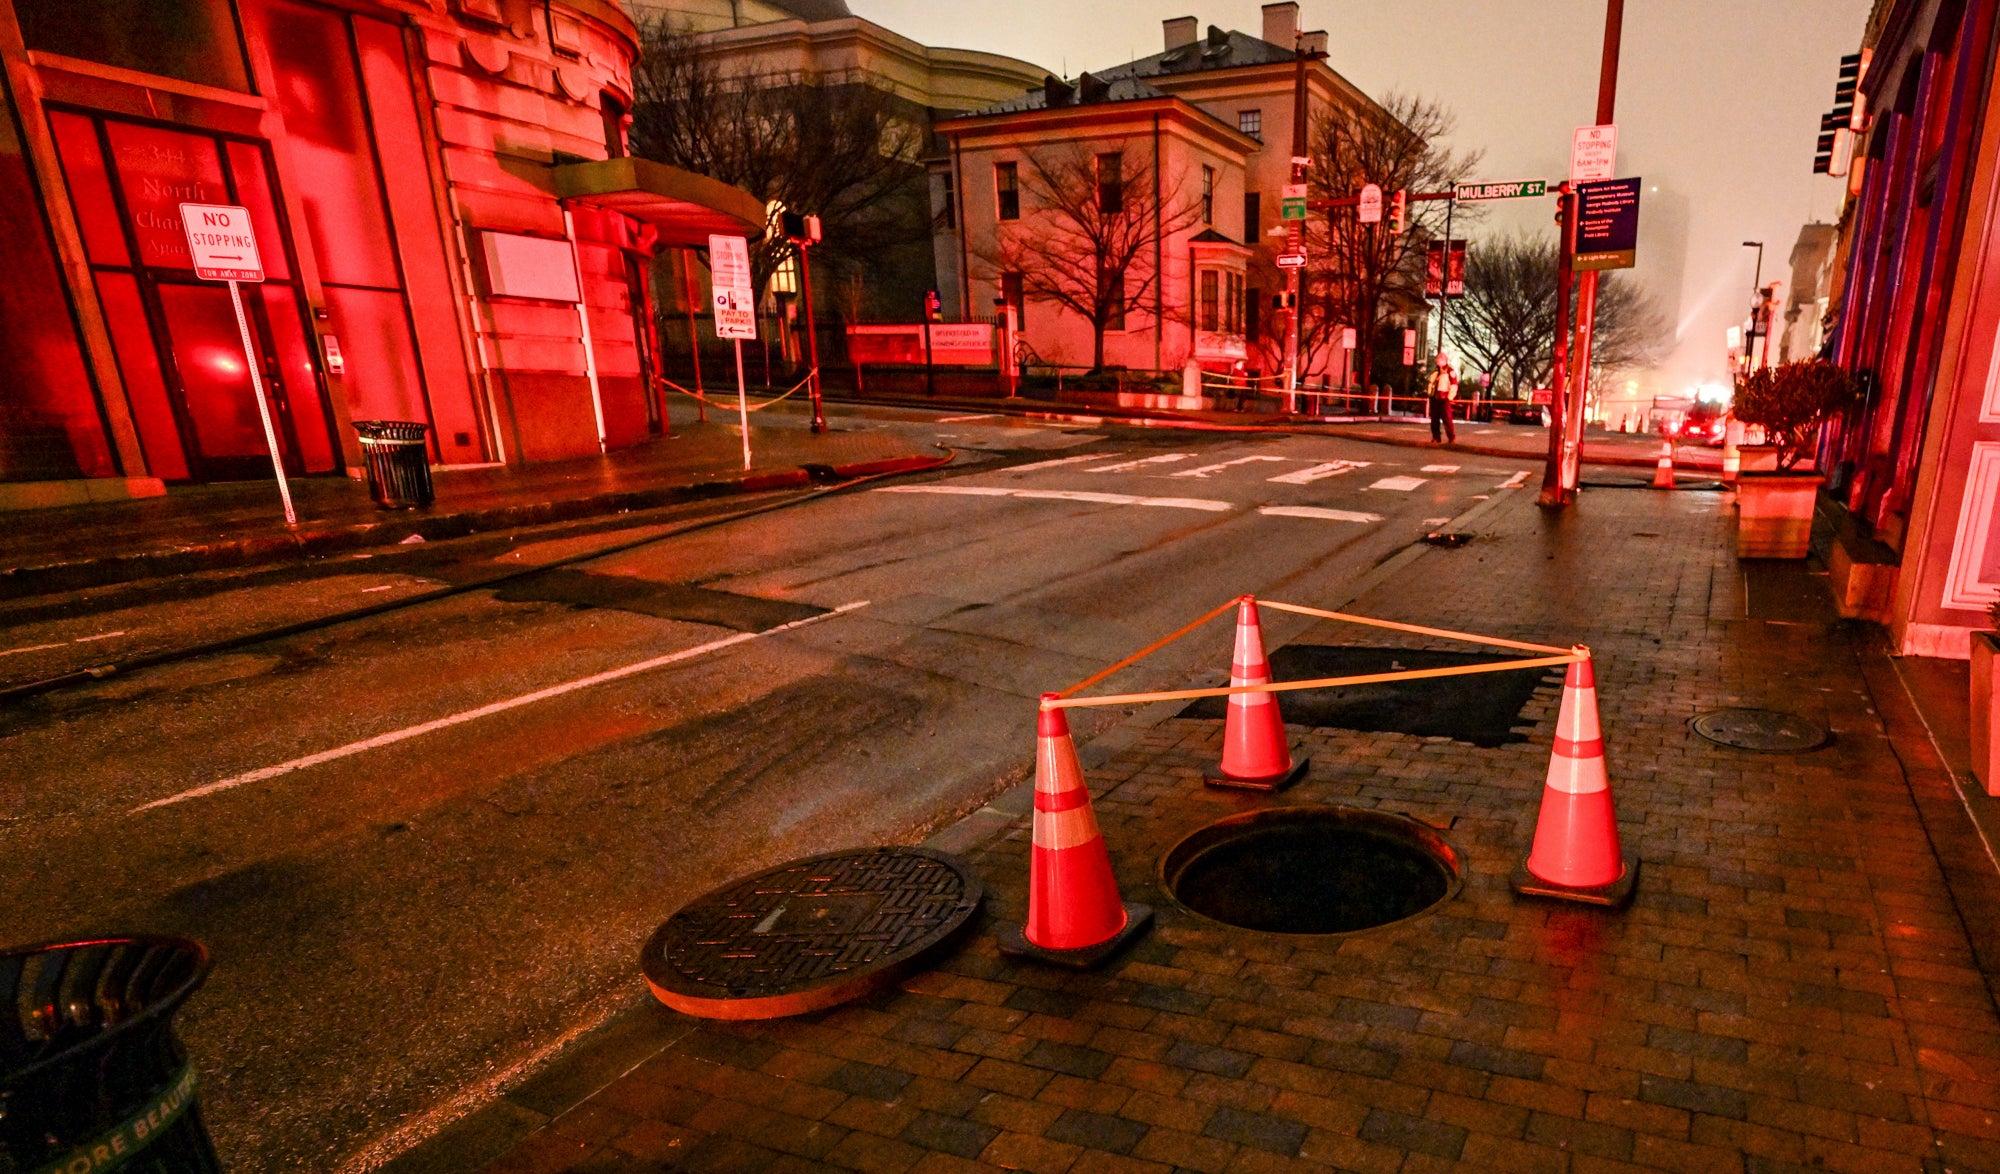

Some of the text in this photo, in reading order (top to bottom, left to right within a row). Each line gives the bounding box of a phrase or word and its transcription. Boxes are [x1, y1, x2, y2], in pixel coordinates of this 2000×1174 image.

[1590, 131, 1601, 139] NO
[1577, 140, 1612, 150] STOPPING
[143, 177, 206, 201] North
[1459, 183, 1544, 199] MULBERRY ST.
[136, 209, 183, 231] Char
[203, 212, 230, 227] NO
[193, 232, 251, 248] STOPPING
[148, 239, 191, 258] Apar
[203, 269, 258, 280] TOW AWAY ZONE
[721, 309, 736, 317] PAY
[725, 317, 747, 325] PARK
[53, 1133, 128, 1174] ORE
